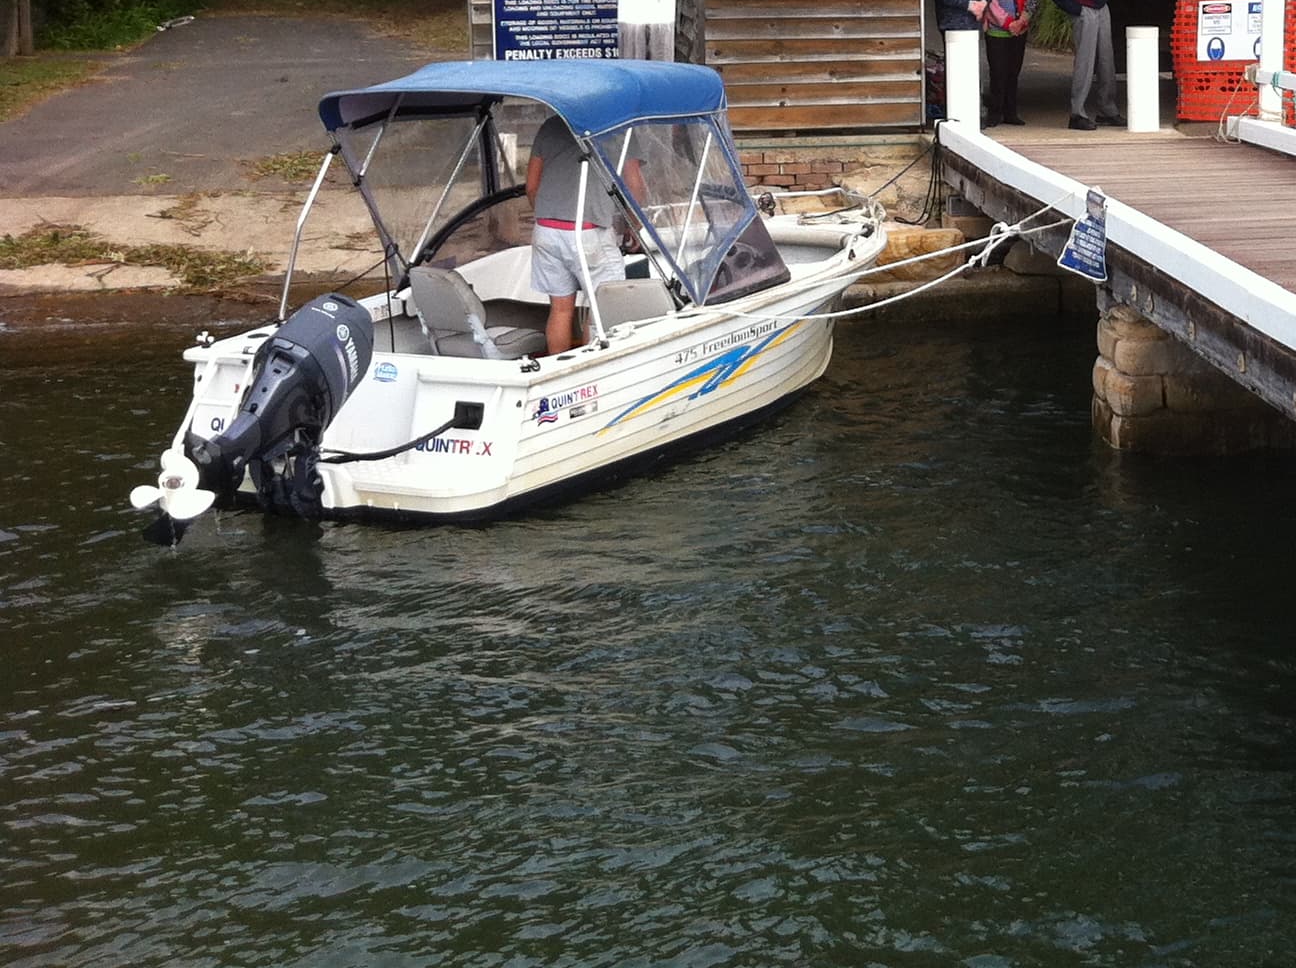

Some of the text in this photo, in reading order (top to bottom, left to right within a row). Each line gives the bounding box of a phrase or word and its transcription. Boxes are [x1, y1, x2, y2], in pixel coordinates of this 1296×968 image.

[504, 49, 553, 61] PENALTY
[555, 47, 603, 59] EXCEEDS
[674, 320, 778, 364] 475 FreedomSport
[551, 384, 599, 409] QUINTREX
[415, 437, 493, 456] QUINTRX
